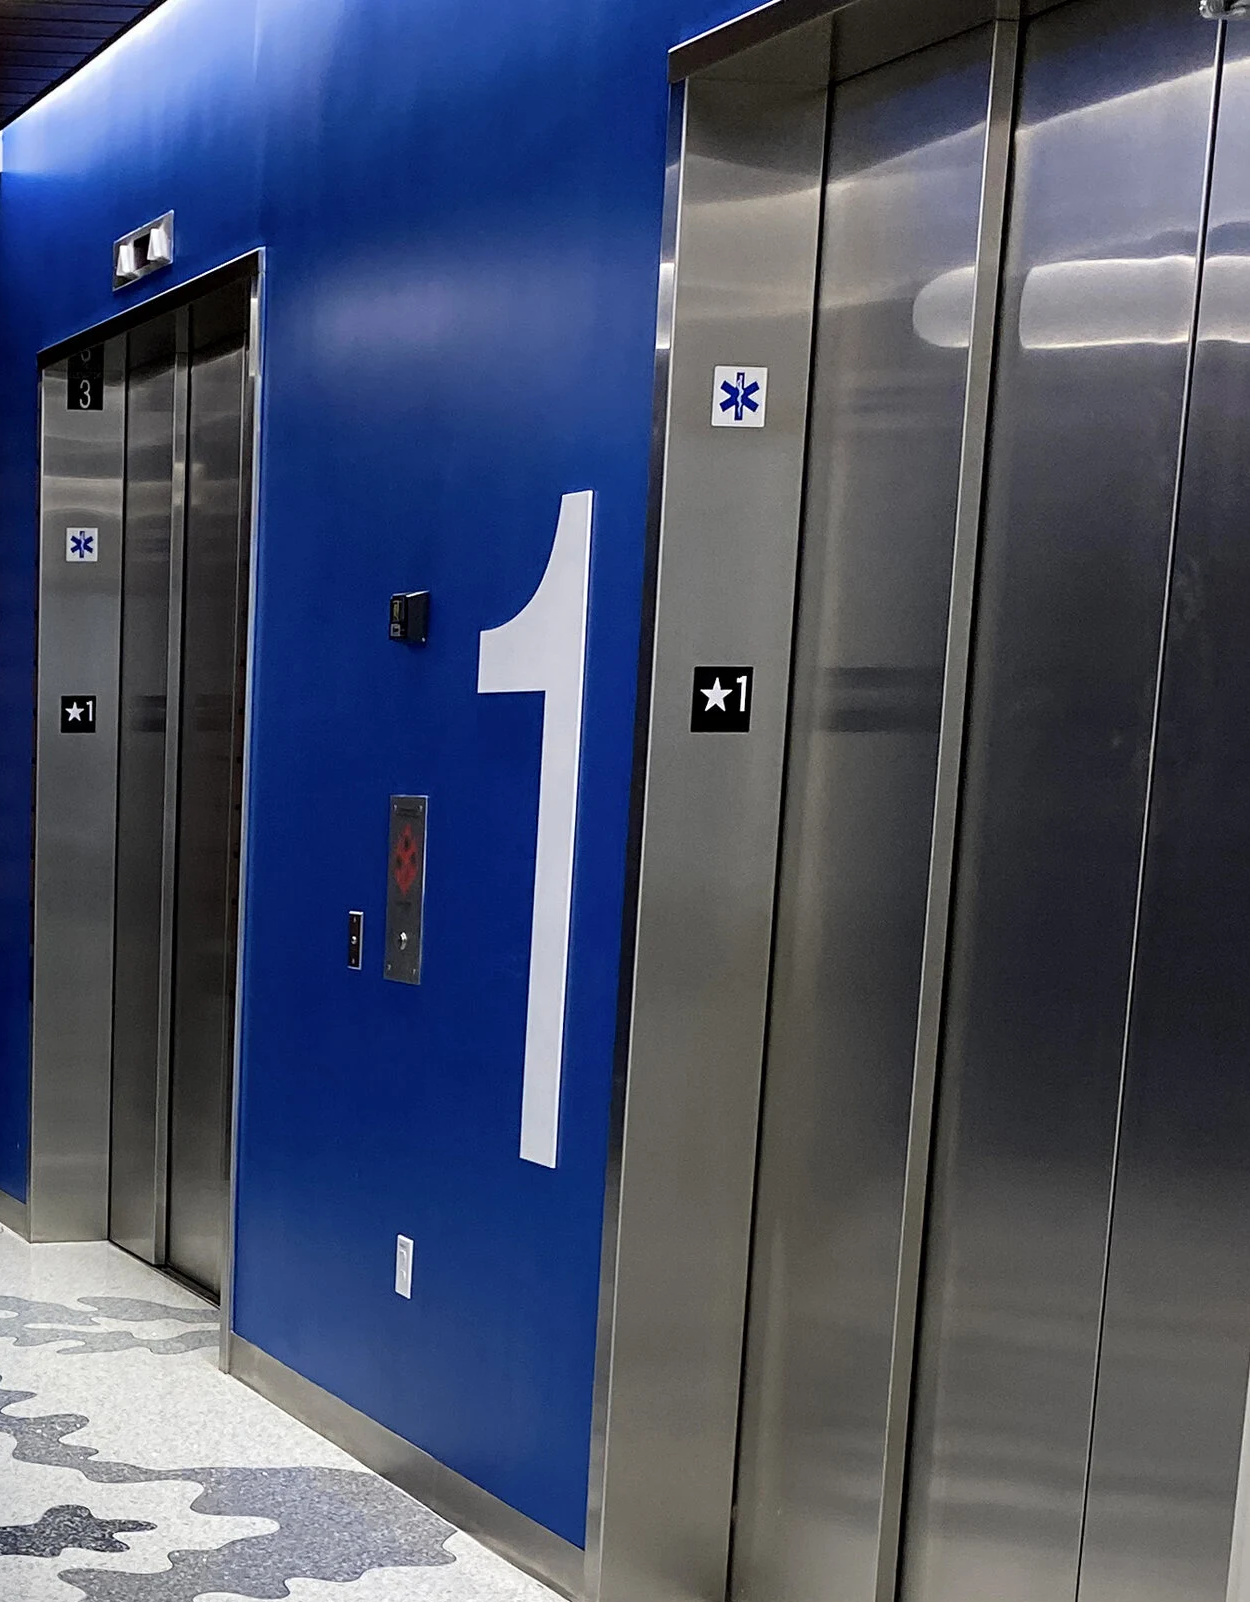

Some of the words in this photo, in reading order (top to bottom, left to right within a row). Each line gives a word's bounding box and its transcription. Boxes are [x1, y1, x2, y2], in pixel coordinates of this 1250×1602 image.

[79, 379, 91, 409] 3
[736, 675, 748, 712] 1
[85, 700, 93, 722] 1
[477, 489, 594, 1170] 1
